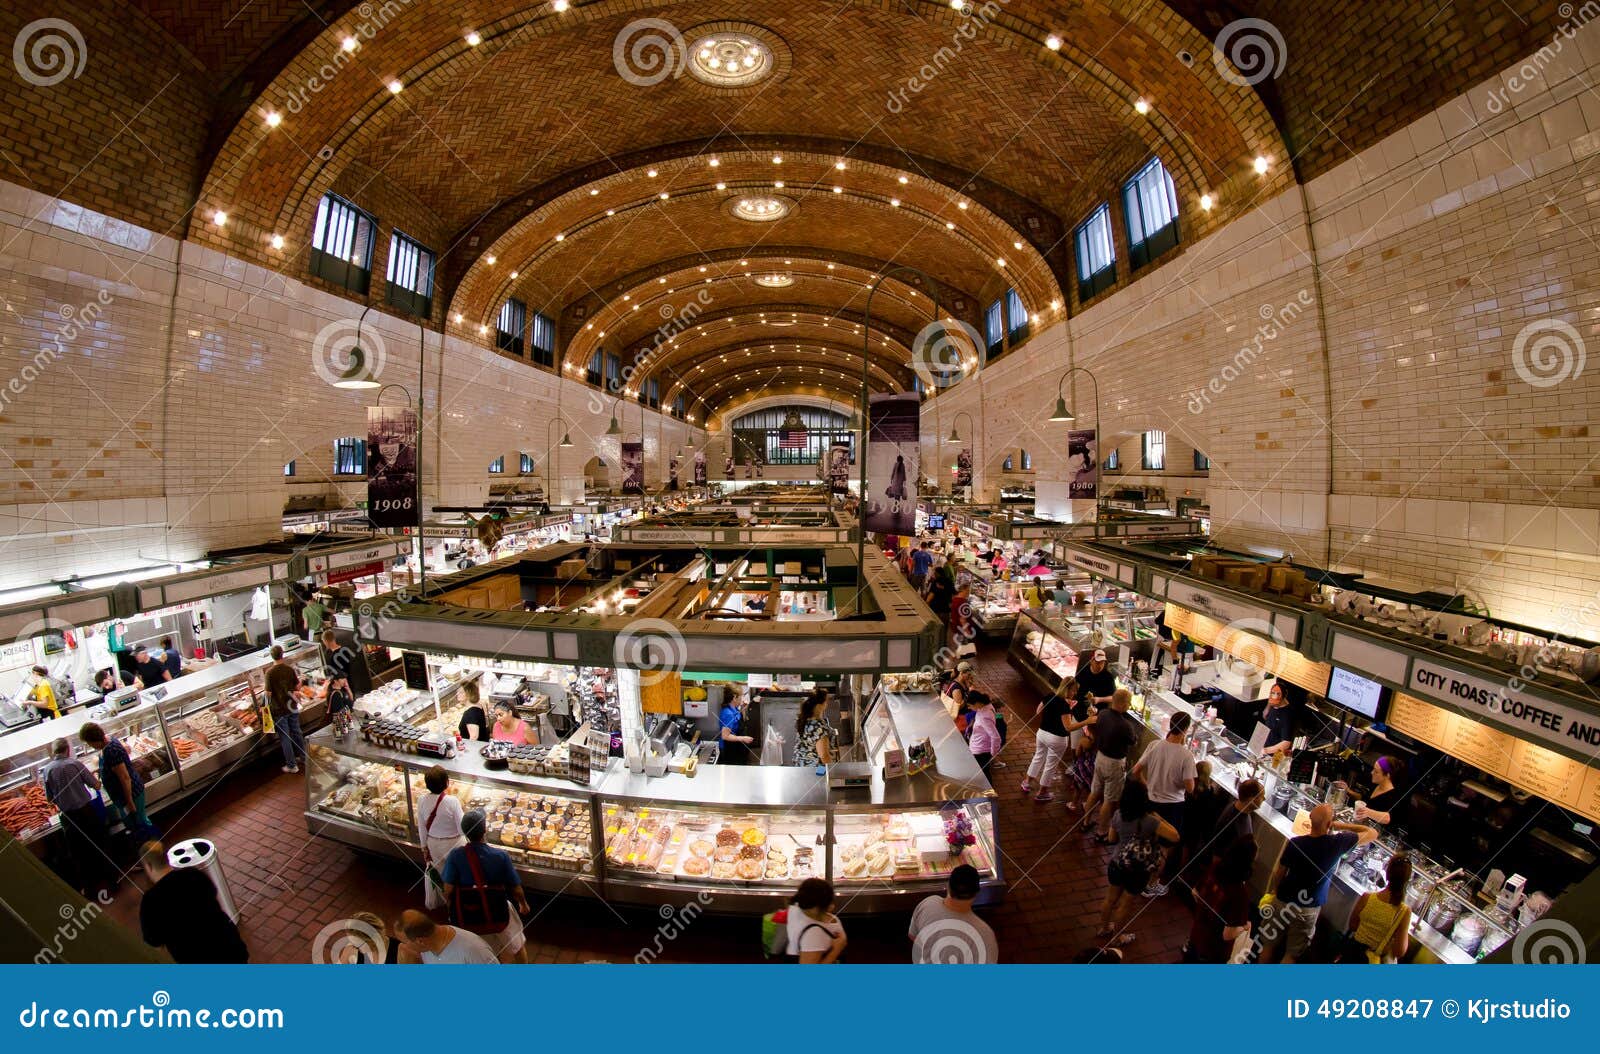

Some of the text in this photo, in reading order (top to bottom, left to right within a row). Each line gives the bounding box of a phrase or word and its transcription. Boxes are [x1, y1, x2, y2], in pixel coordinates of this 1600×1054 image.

[373, 497, 412, 512] 1908
[870, 499, 912, 514] 1980
[1417, 669, 1447, 690] CITY
[1450, 680, 1498, 707] ROAST
[1501, 699, 1563, 732] COFFEE
